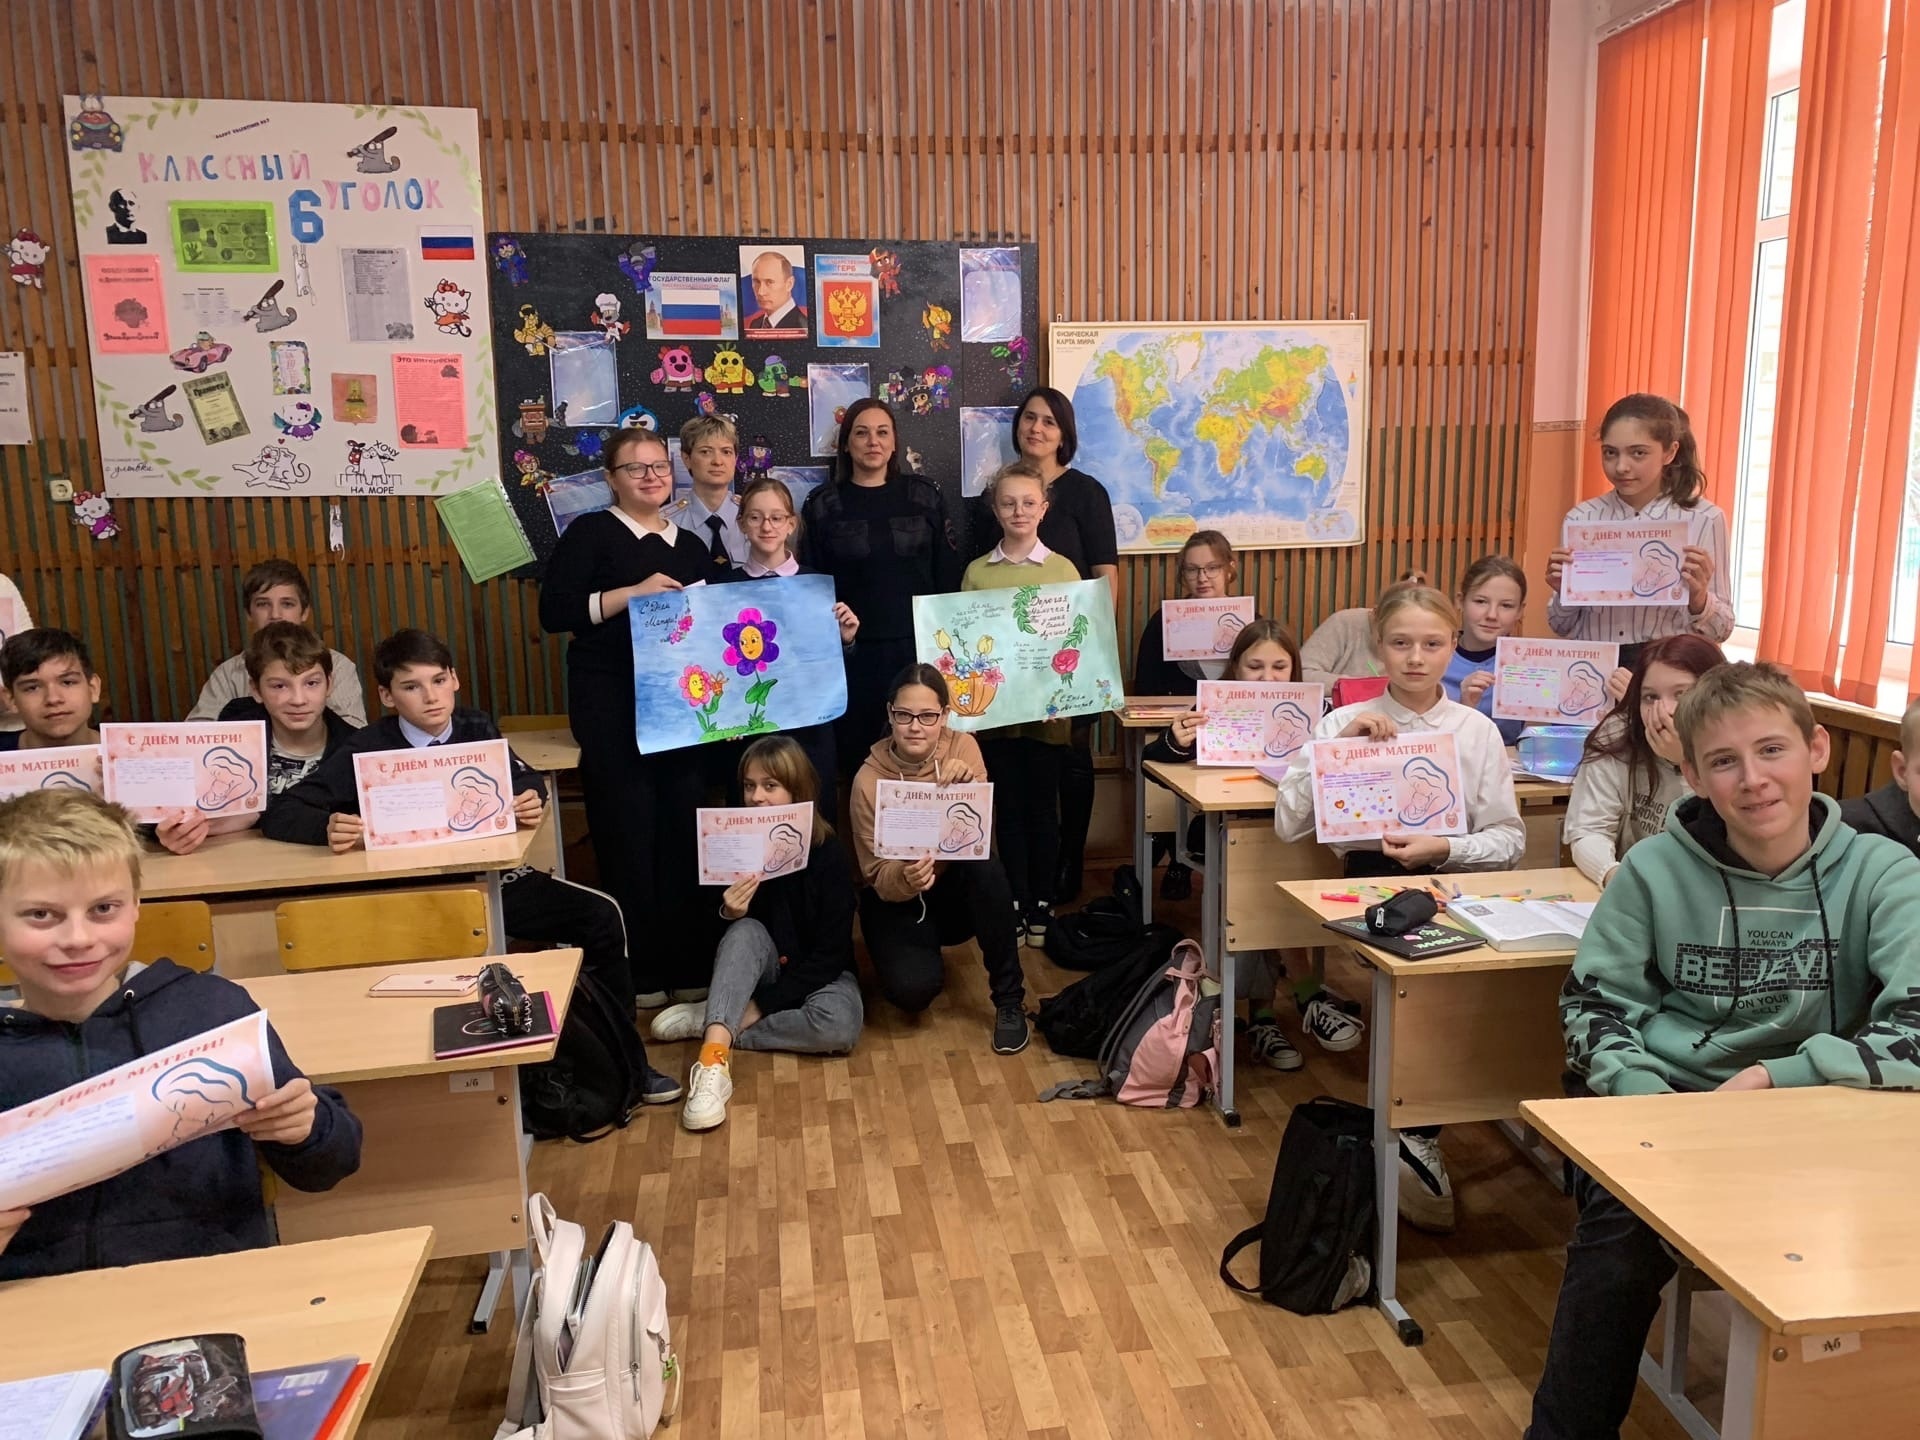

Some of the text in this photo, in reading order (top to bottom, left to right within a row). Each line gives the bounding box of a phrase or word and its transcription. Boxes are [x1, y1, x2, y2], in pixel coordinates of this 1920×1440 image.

[138, 150, 310, 183] КЛАССНЫЙ
[322, 178, 444, 212] УГОЛОК
[288, 189, 324, 243] 6
[836, 264, 857, 272] ГЕРБ
[373, 439, 400, 457] ХОЧУ
[350, 486, 395, 495] НА МОРЕ
[1582, 530, 1589, 541] С
[1626, 529, 1673, 540] МАТЕРИ!
[1514, 647, 1521, 656] С
[1557, 648, 1601, 660] МАТЕРИ!
[1216, 690, 1223, 699] С
[1260, 691, 1305, 700] МАТЕРИ!
[128, 736, 136, 746] С
[185, 733, 243, 745] МАТЕРИ!
[1333, 750, 1341, 760] С
[1385, 743, 1438, 757] МАТЕРИ!
[22, 758, 80, 772] МАТЕРИ!
[380, 763, 388, 773] С
[433, 753, 487, 768] МАТЕРИ!
[895, 790, 901, 799] С
[935, 792, 977, 801] МАТЕРИ!
[757, 812, 797, 824] МАТЕРИ!
[1747, 929, 1793, 940] YOU CAN
[1750, 939, 1788, 948] ALWAYS
[1736, 994, 1790, 1010] ON YOUR
[127, 1036, 225, 1080] МАТЕРИ!
